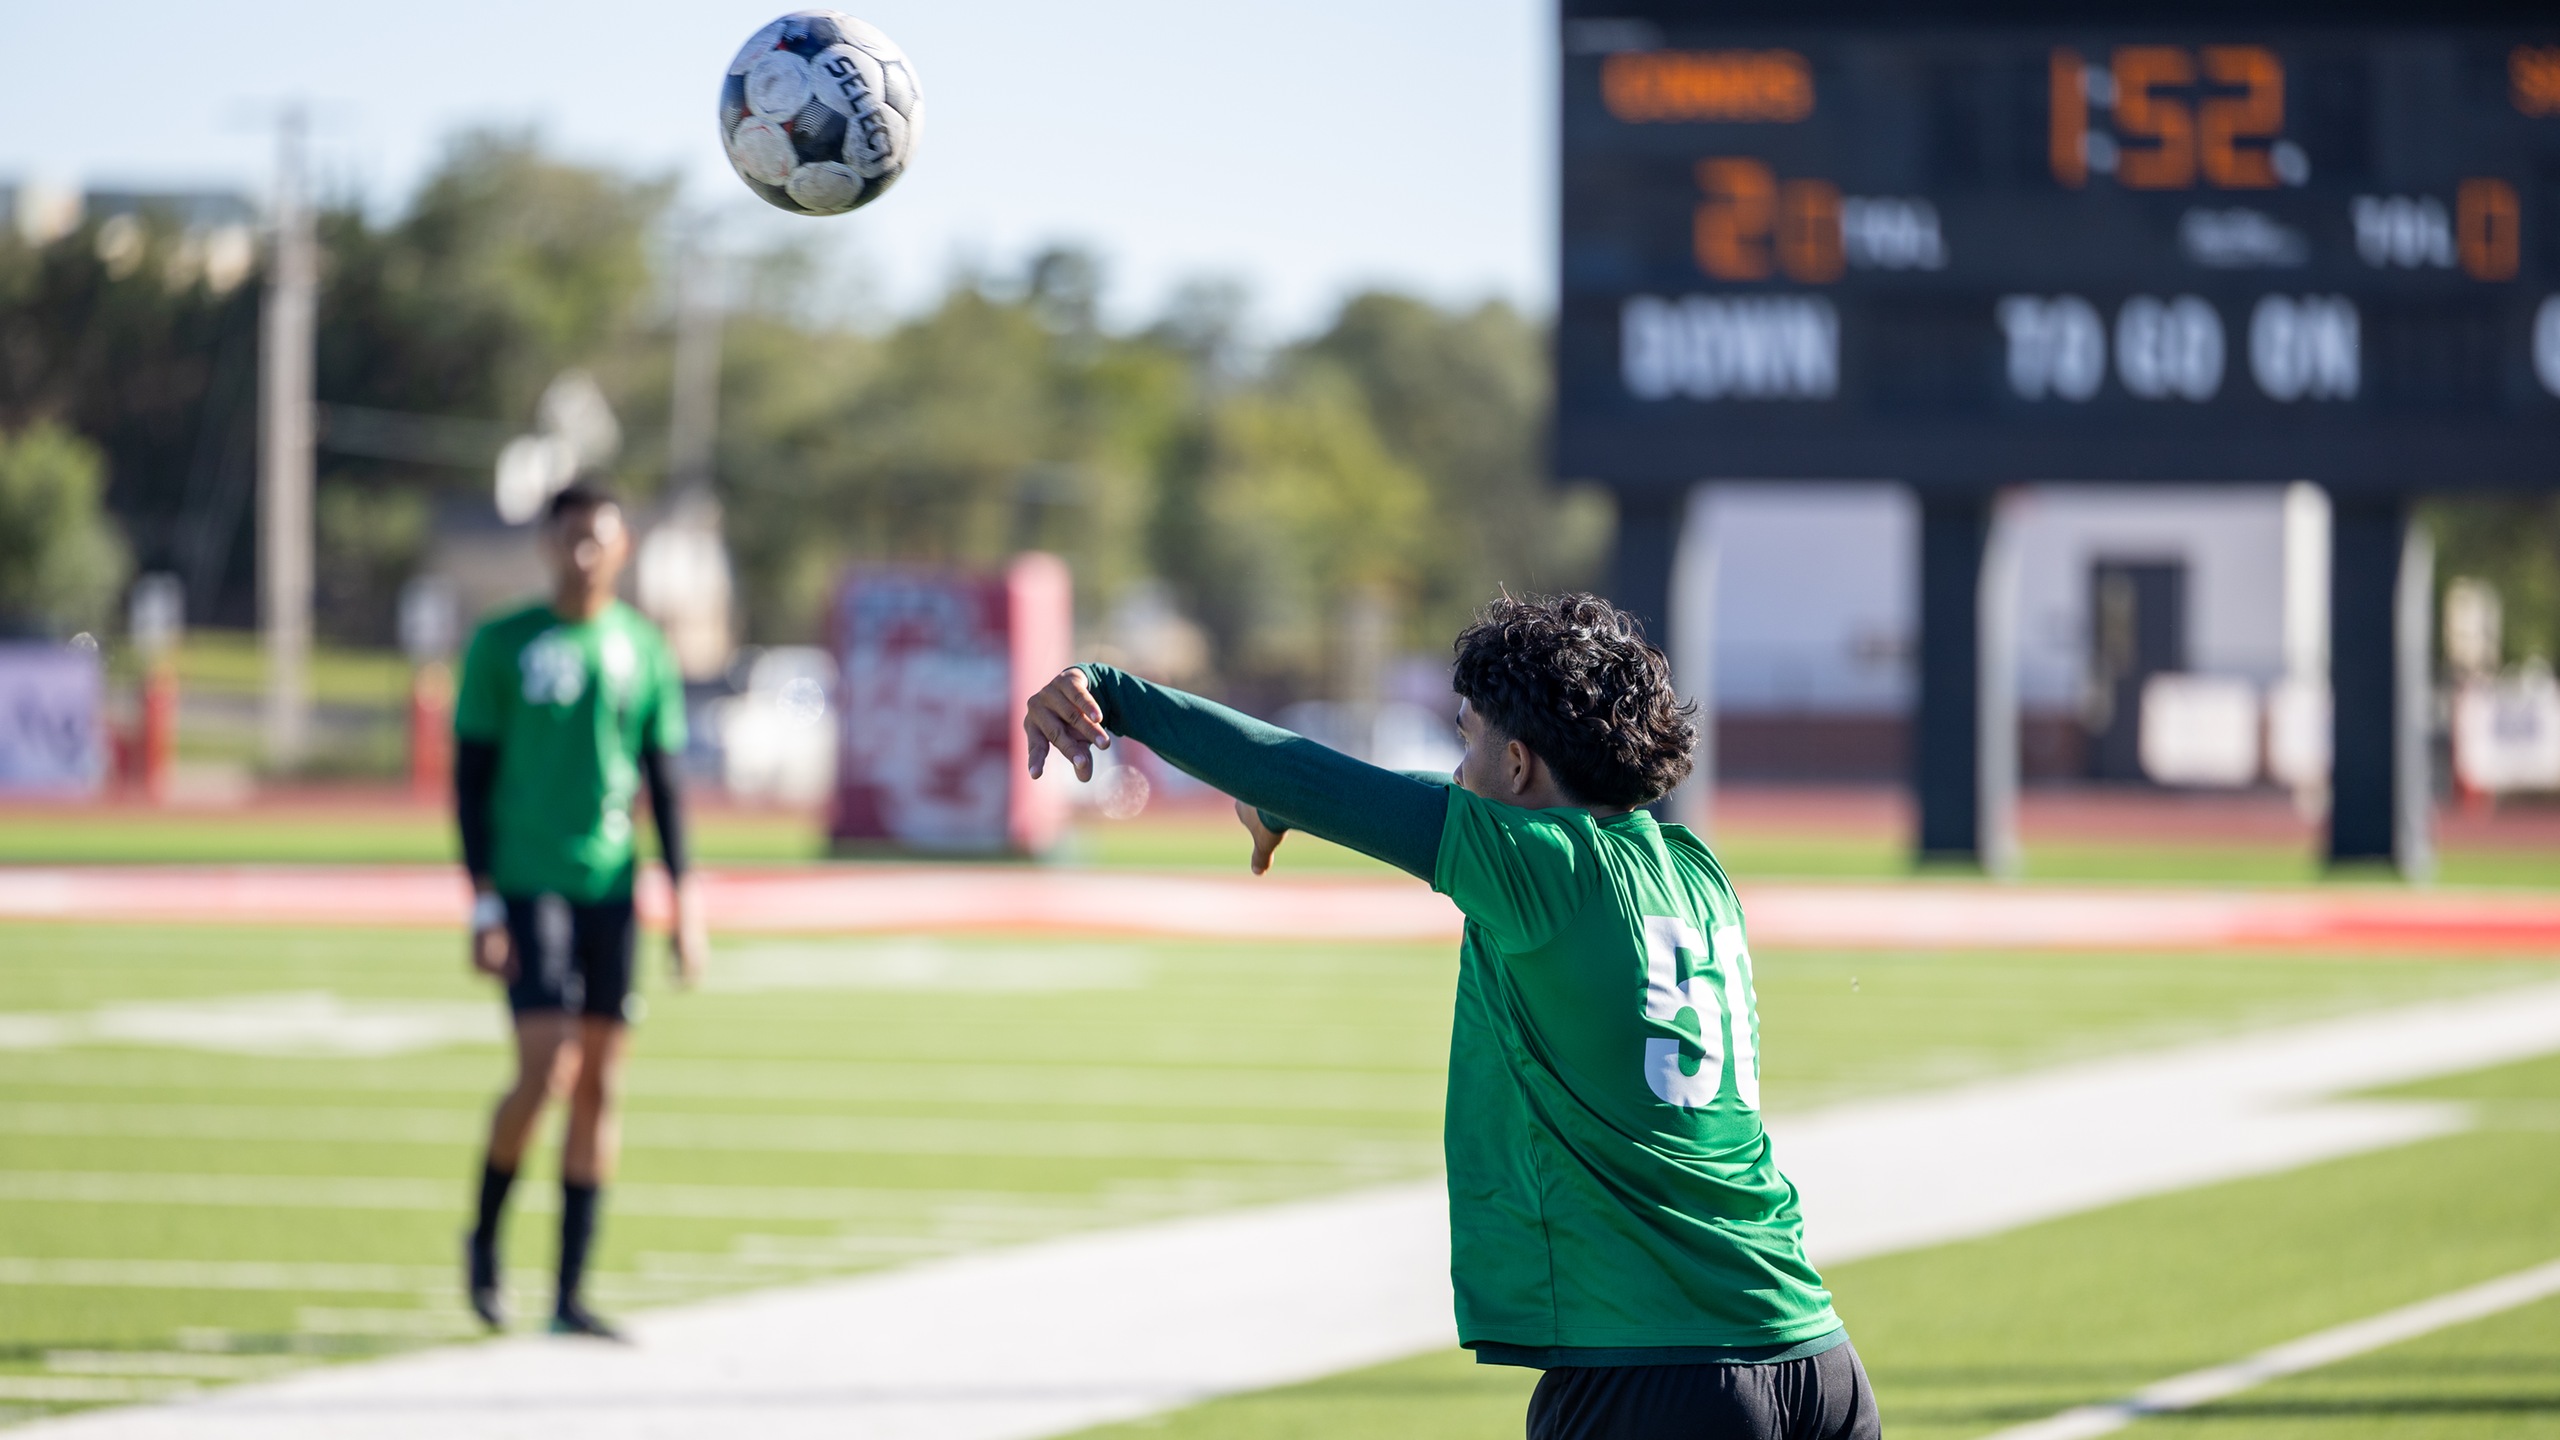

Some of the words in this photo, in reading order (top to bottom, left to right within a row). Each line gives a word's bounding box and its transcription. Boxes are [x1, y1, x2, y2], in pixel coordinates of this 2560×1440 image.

[824, 55, 893, 164] SELECT
[1620, 295, 1841, 400] DOWN
[1997, 295, 2107, 400] TO
[2114, 295, 2227, 400] GO
[2247, 295, 2362, 400] ON
